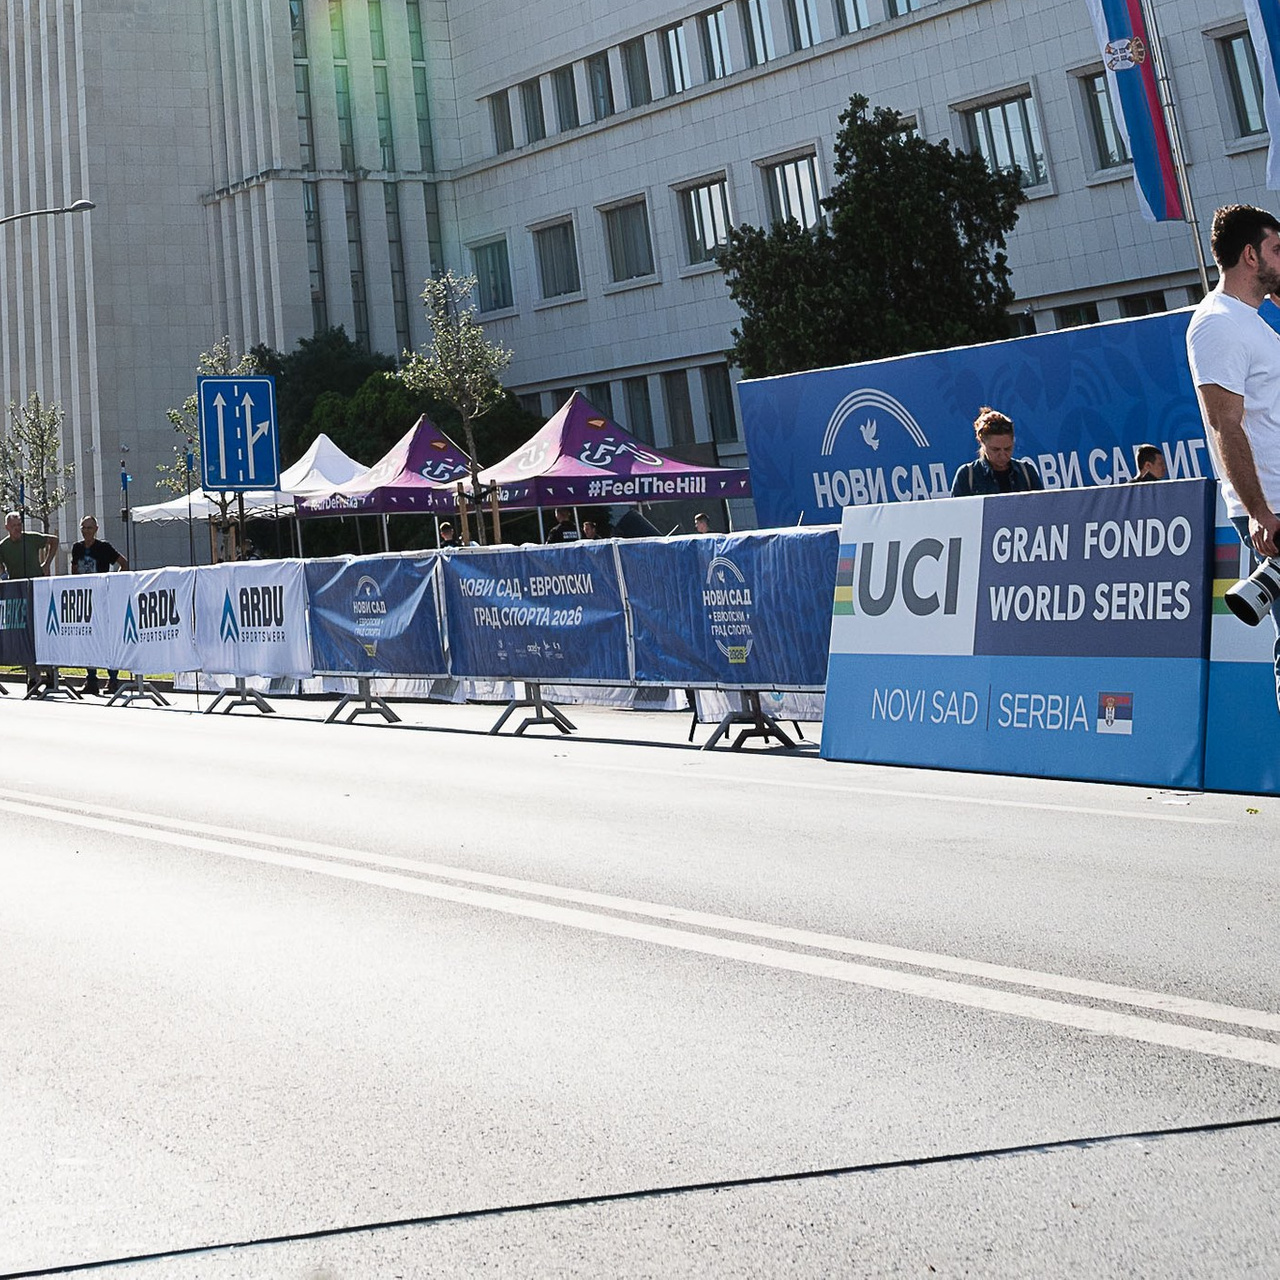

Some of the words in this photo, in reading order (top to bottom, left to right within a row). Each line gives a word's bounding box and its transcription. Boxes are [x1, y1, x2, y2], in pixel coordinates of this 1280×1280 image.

[588, 477, 706, 497] #FeelTheHill
[813, 466, 887, 509] НОВИ
[892, 462, 950, 501] САД
[992, 523, 1069, 565] GRAN
[1084, 516, 1192, 561] FONDO
[459, 578, 495, 597] НОВИ
[496, 578, 522, 600] САД
[529, 573, 593, 597] ЕВРОПСКИ
[857, 537, 962, 617] UCI
[60, 588, 92, 623] ARDU
[239, 585, 284, 627] ARDU
[729, 589, 752, 606] САД
[989, 584, 1085, 622] WORLD
[1092, 581, 1191, 621] SERIES
[474, 607, 502, 629] ГРАД
[501, 607, 550, 626] СПОРТА
[551, 606, 582, 626] 2026
[241, 631, 286, 643] SPORTSWEAR
[871, 687, 926, 723] NOVI
[930, 690, 978, 725] SAD
[998, 692, 1089, 731] SERBIA
